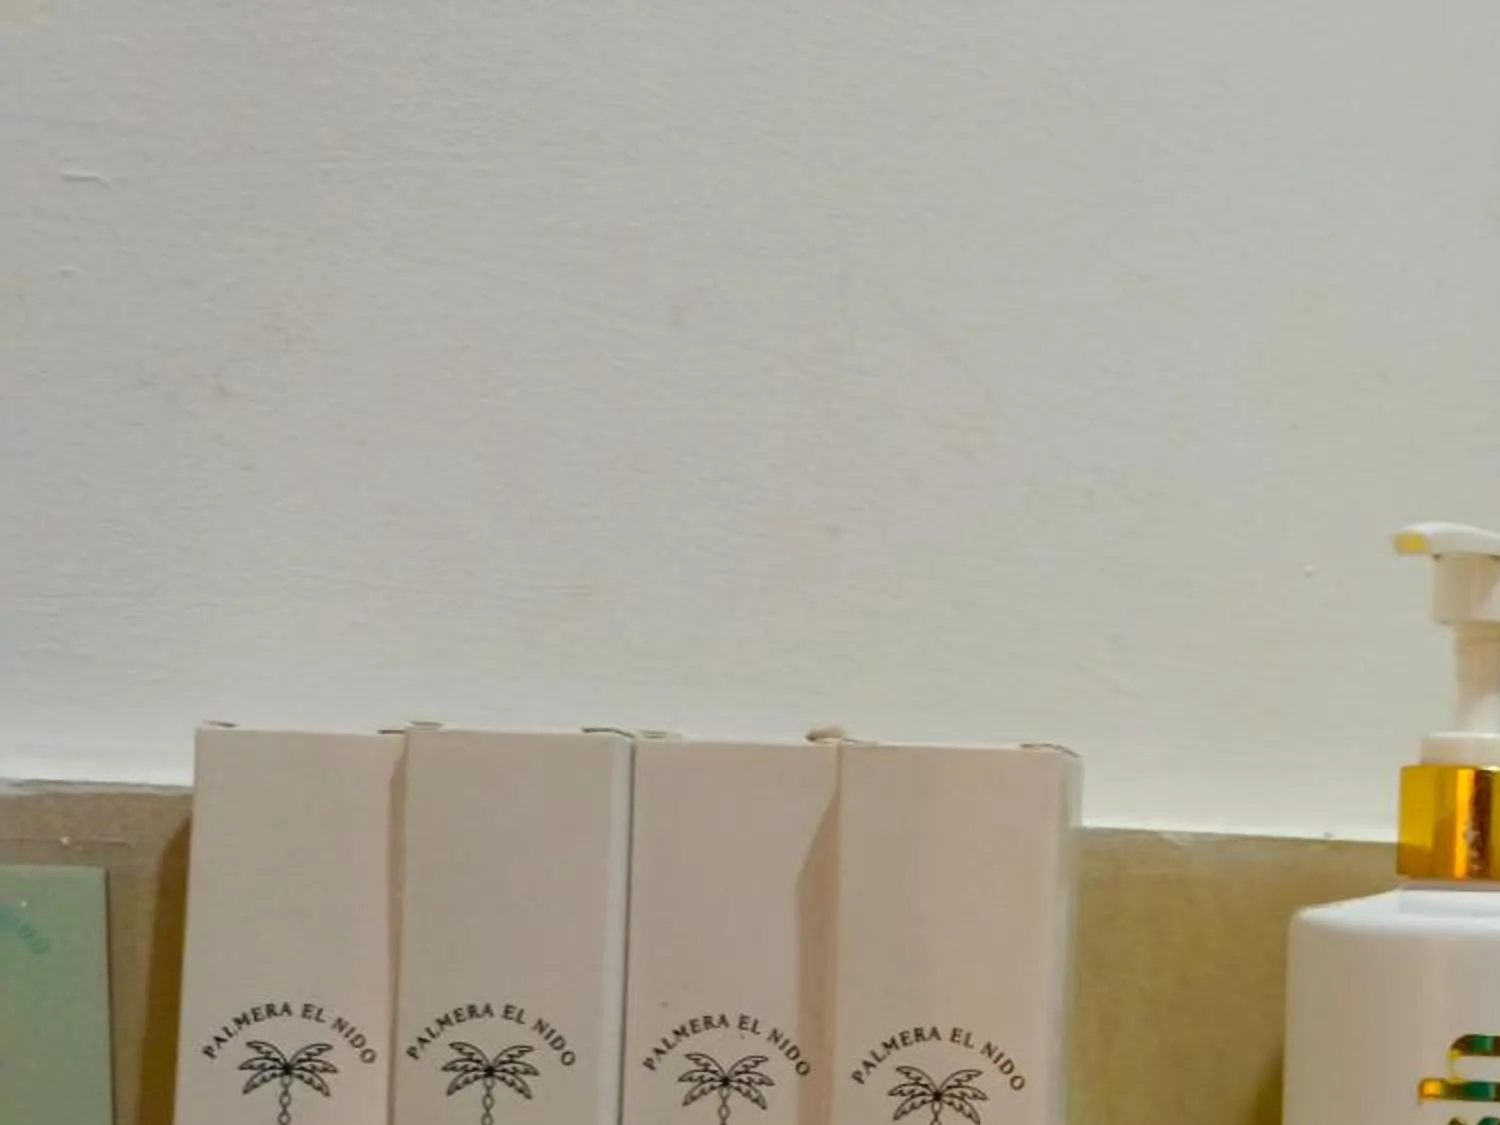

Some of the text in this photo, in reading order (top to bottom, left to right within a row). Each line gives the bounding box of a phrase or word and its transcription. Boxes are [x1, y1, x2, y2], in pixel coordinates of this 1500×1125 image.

[202, 1002, 378, 1066] PALMERA EL NIDO
[406, 1002, 577, 1068] PALMERA EL NIDO
[642, 1013, 812, 1078] PALMERA EL NIDO
[851, 1025, 1027, 1092] PALMERA EL NIDO
